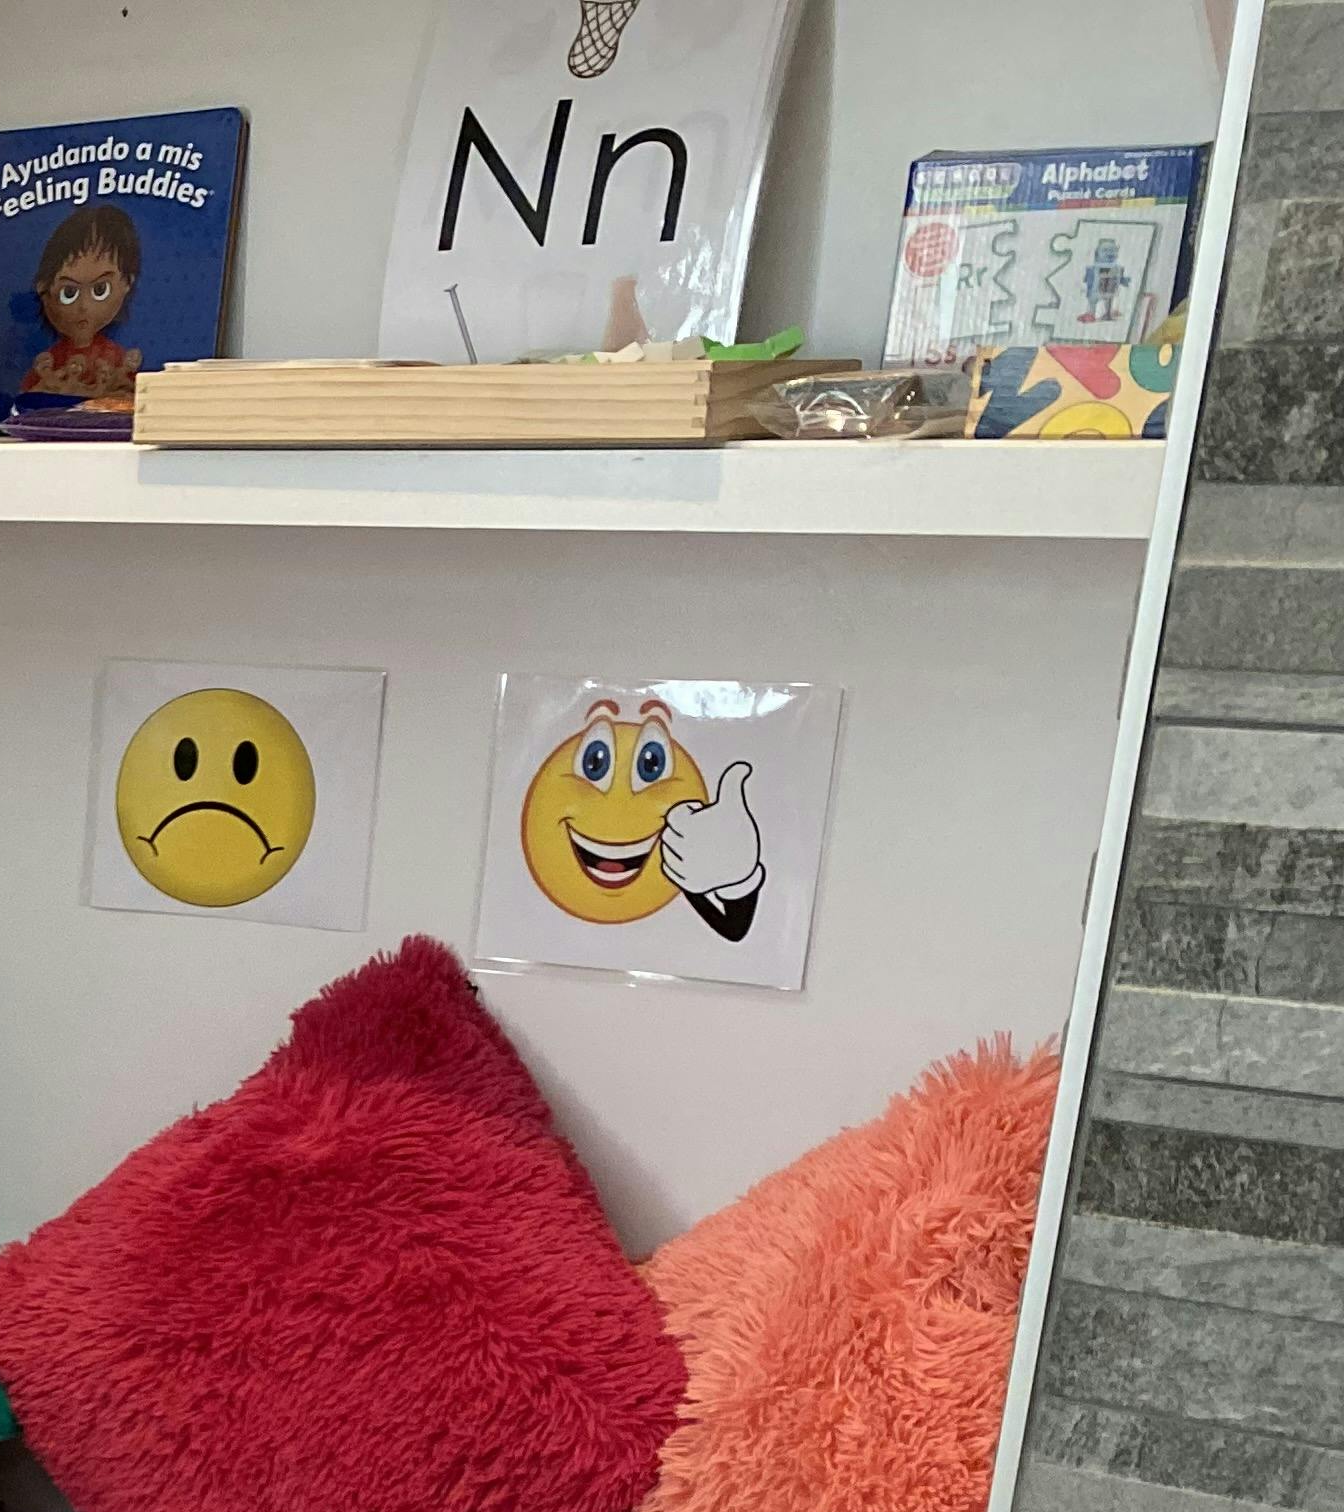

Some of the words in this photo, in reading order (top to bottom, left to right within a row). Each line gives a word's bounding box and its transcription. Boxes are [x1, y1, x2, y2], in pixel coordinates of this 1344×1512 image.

[0, 135, 130, 190] Ayudando
[135, 142, 154, 161] a
[158, 143, 205, 171] mis
[438, 98, 688, 251] Nn
[1040, 158, 1150, 191] Alphabet
